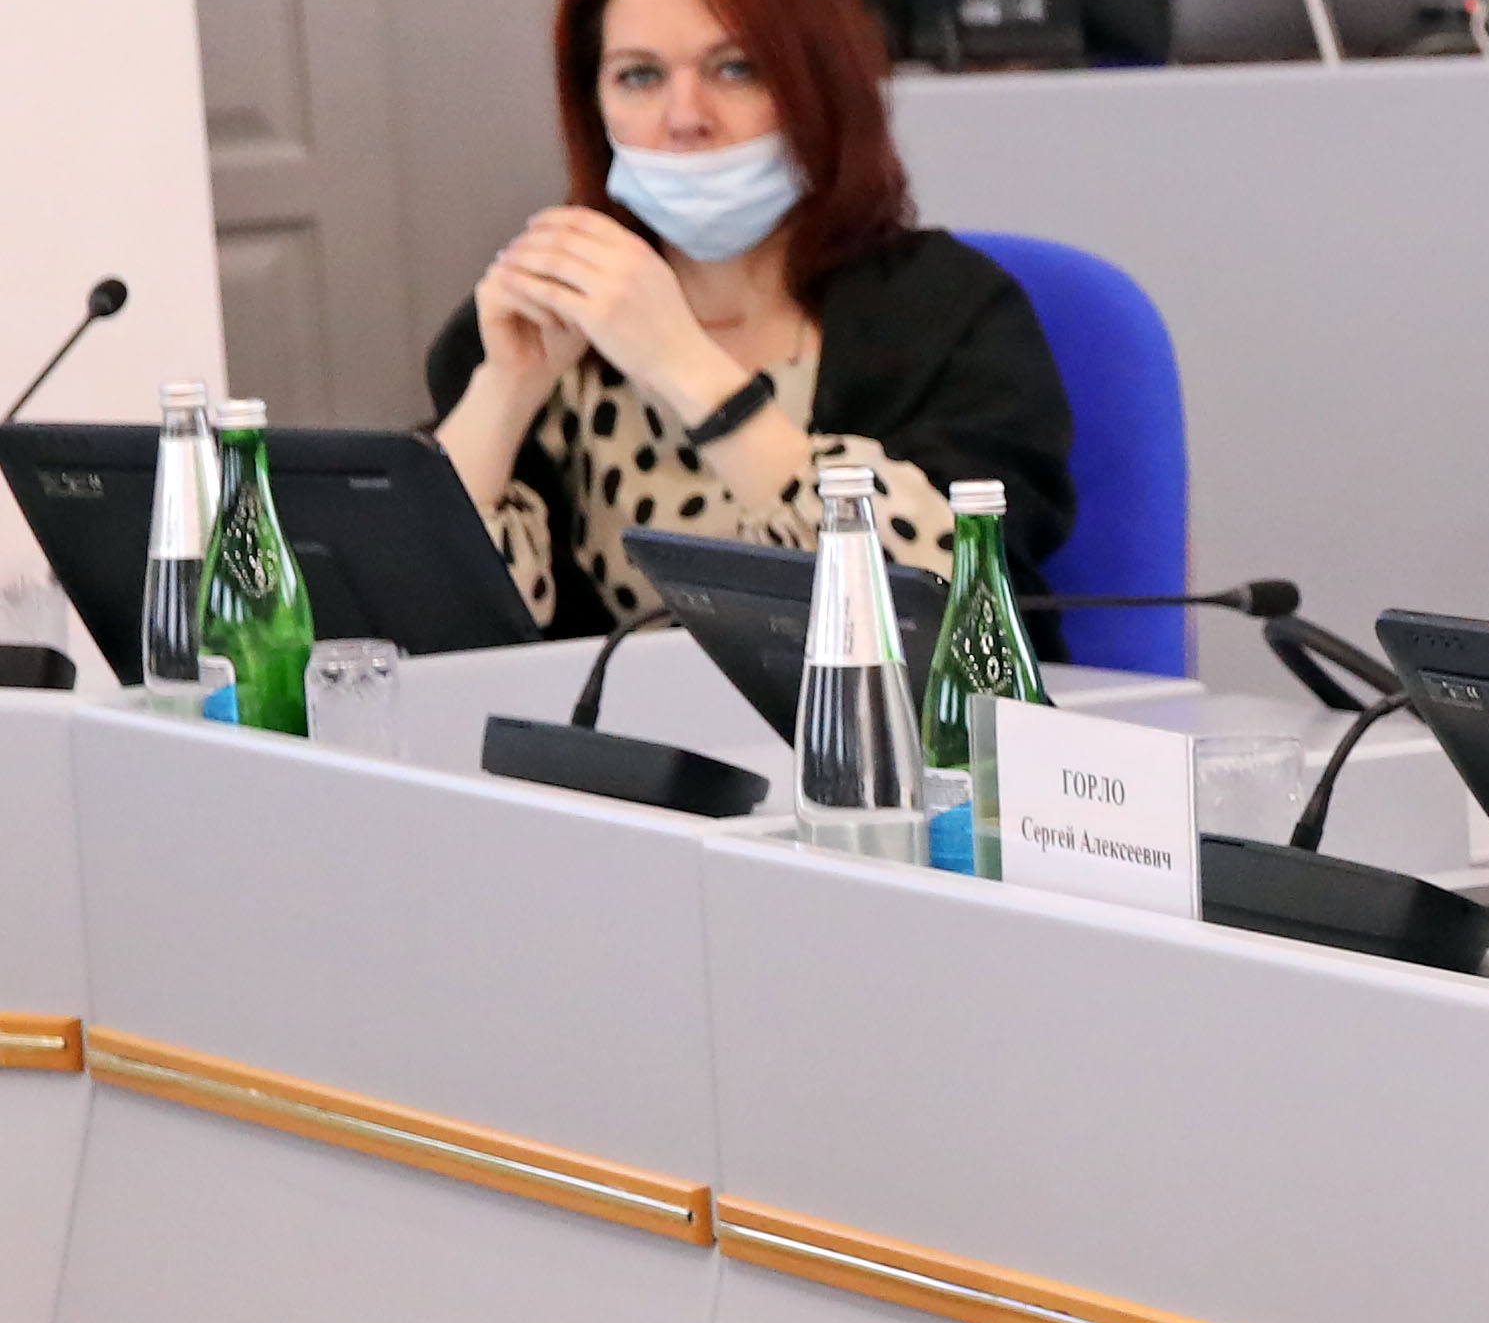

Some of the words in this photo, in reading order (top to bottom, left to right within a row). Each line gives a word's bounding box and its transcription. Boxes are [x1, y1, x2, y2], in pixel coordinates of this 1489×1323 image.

[1062, 768, 1125, 805] ГОРЛО
[1021, 816, 1075, 852] Сергей
[1081, 829, 1172, 870] Алексеевич
